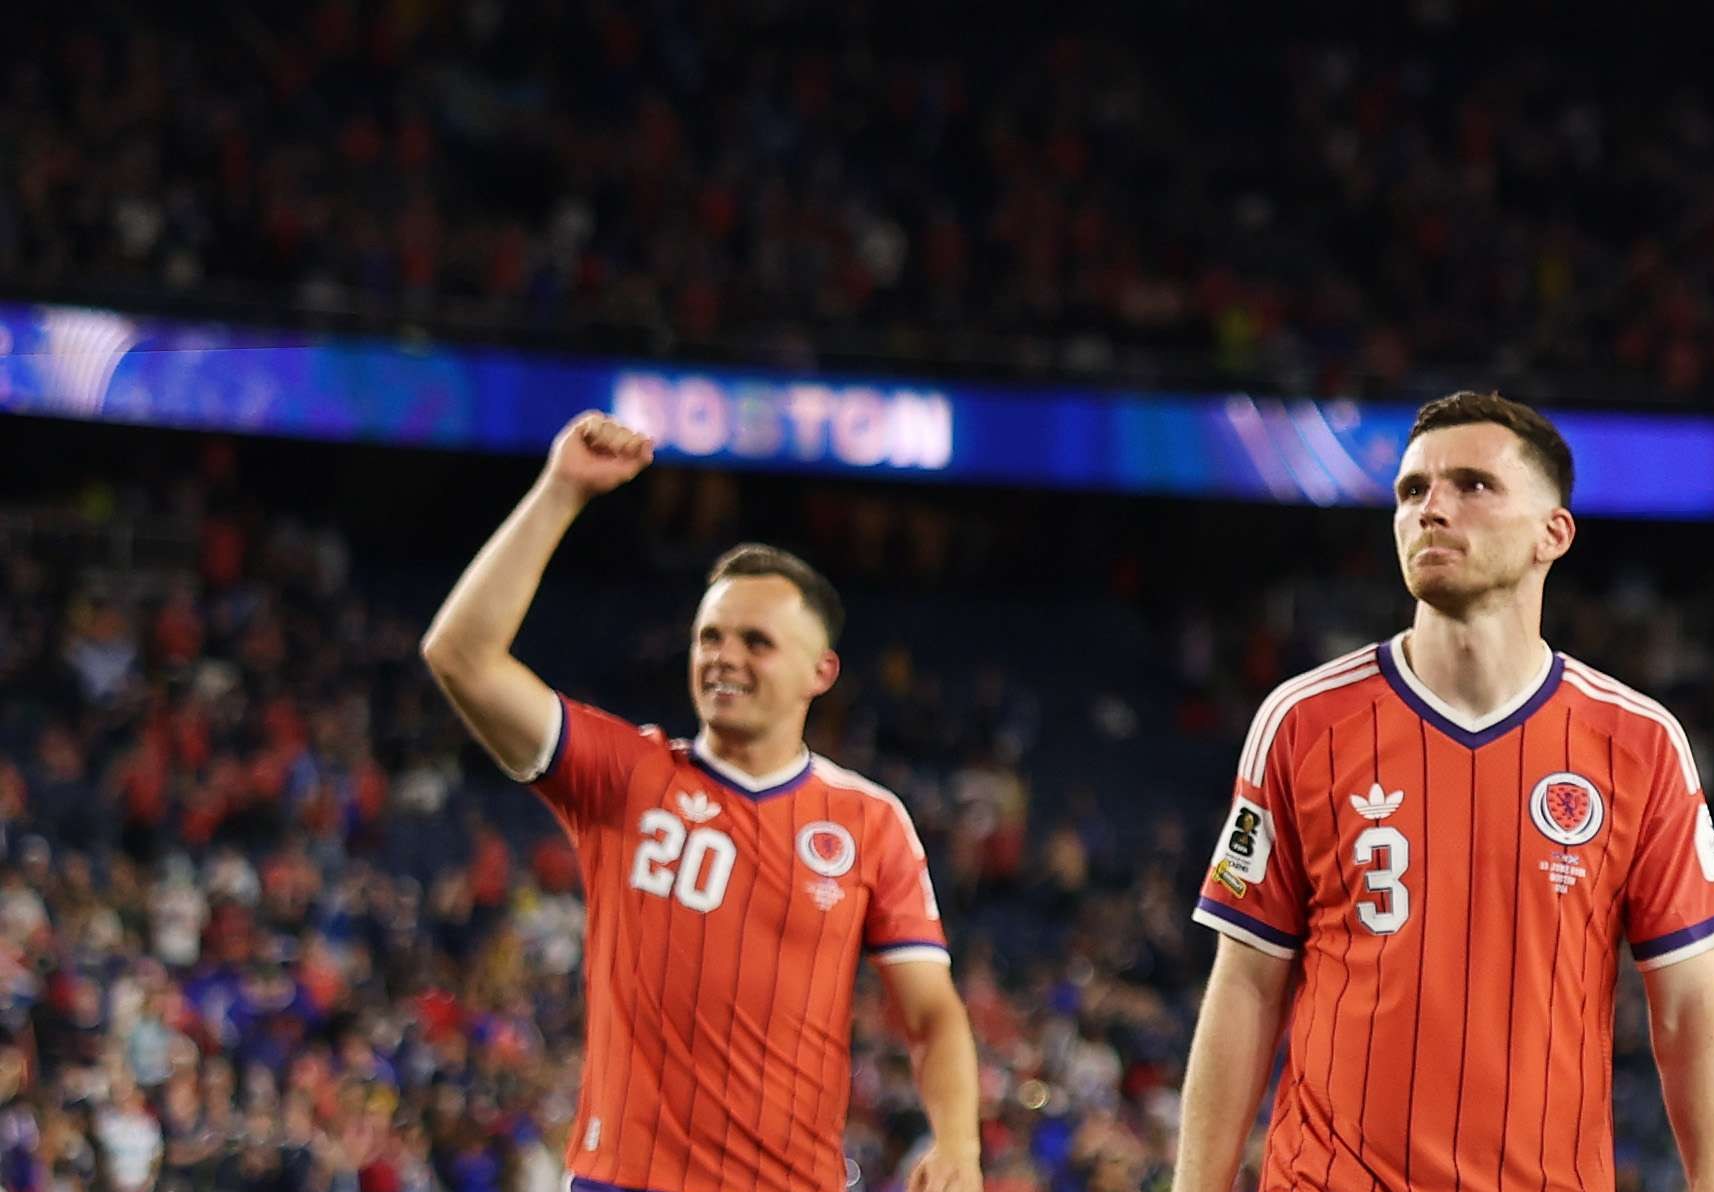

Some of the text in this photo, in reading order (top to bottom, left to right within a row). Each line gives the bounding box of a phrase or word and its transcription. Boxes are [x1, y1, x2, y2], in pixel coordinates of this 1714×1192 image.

[611, 371, 953, 471] BOSTON
[629, 806, 737, 914] 20
[1353, 826, 1411, 935] 3
